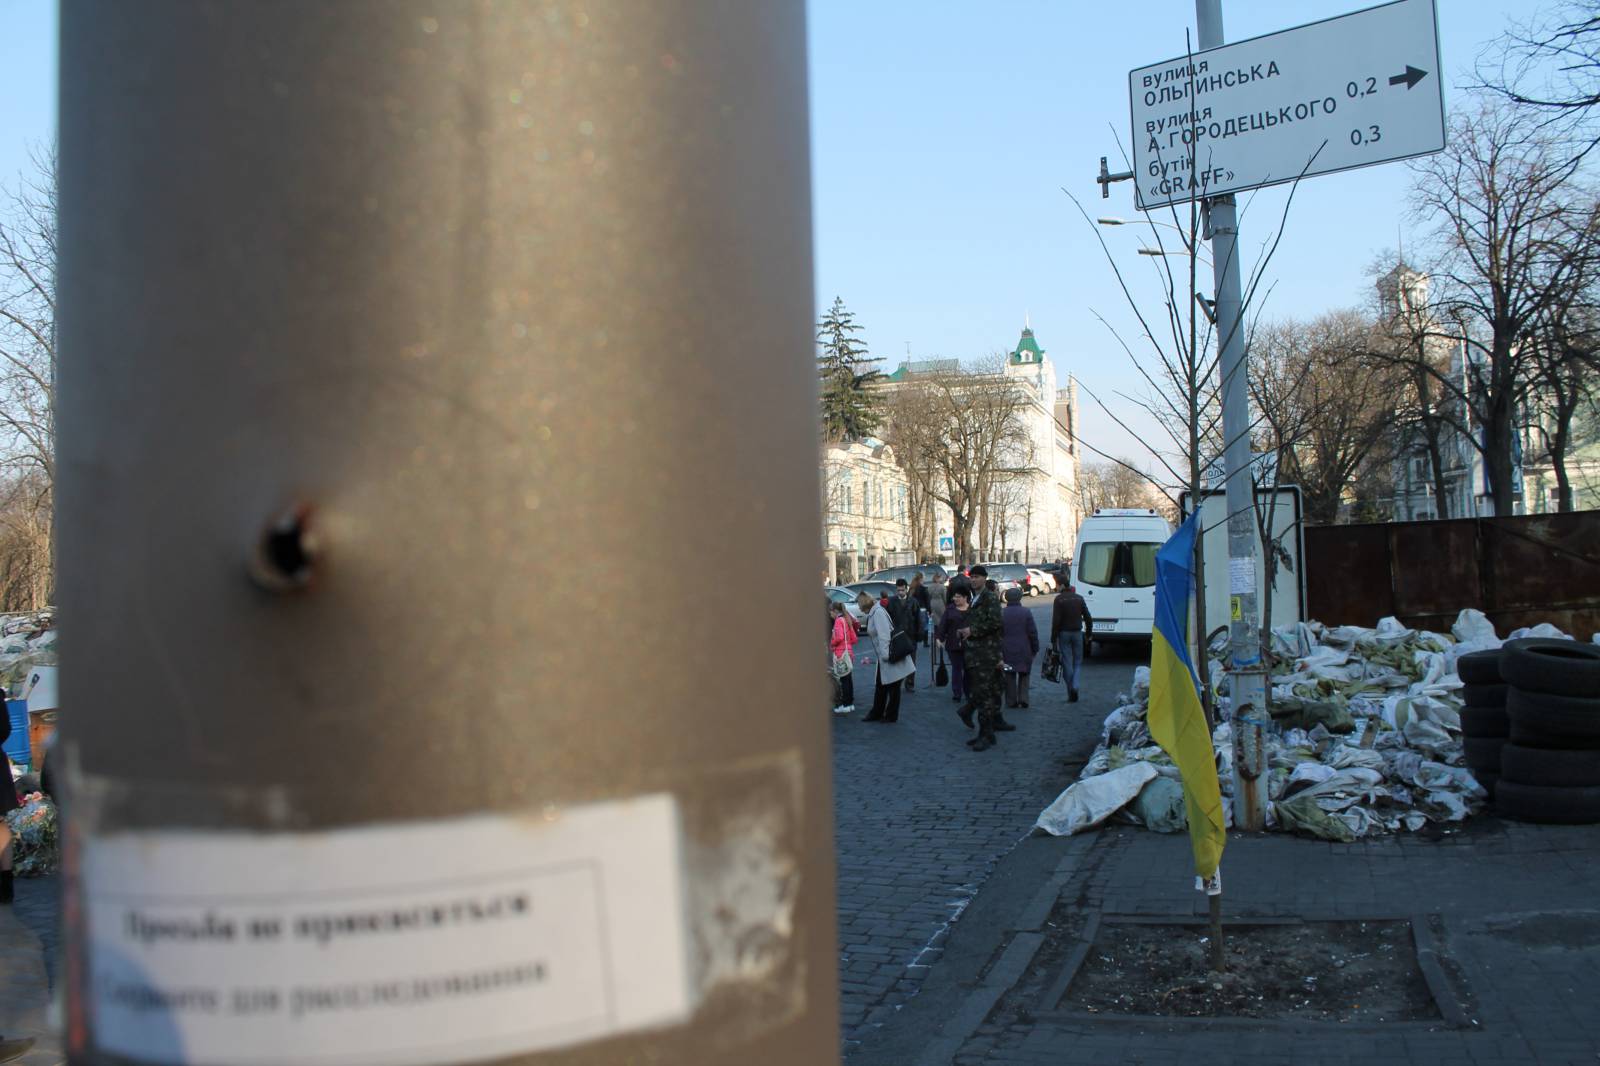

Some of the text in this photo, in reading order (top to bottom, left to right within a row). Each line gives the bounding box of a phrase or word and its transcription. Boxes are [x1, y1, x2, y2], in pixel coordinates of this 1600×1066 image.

[1143, 60, 1208, 88] вулиця
[1144, 60, 1281, 107] ОЛЬГИНСЬКА
[1346, 77, 1379, 100] 0,2
[1146, 107, 1213, 134] вулиця
[1350, 125, 1382, 147] 0,3
